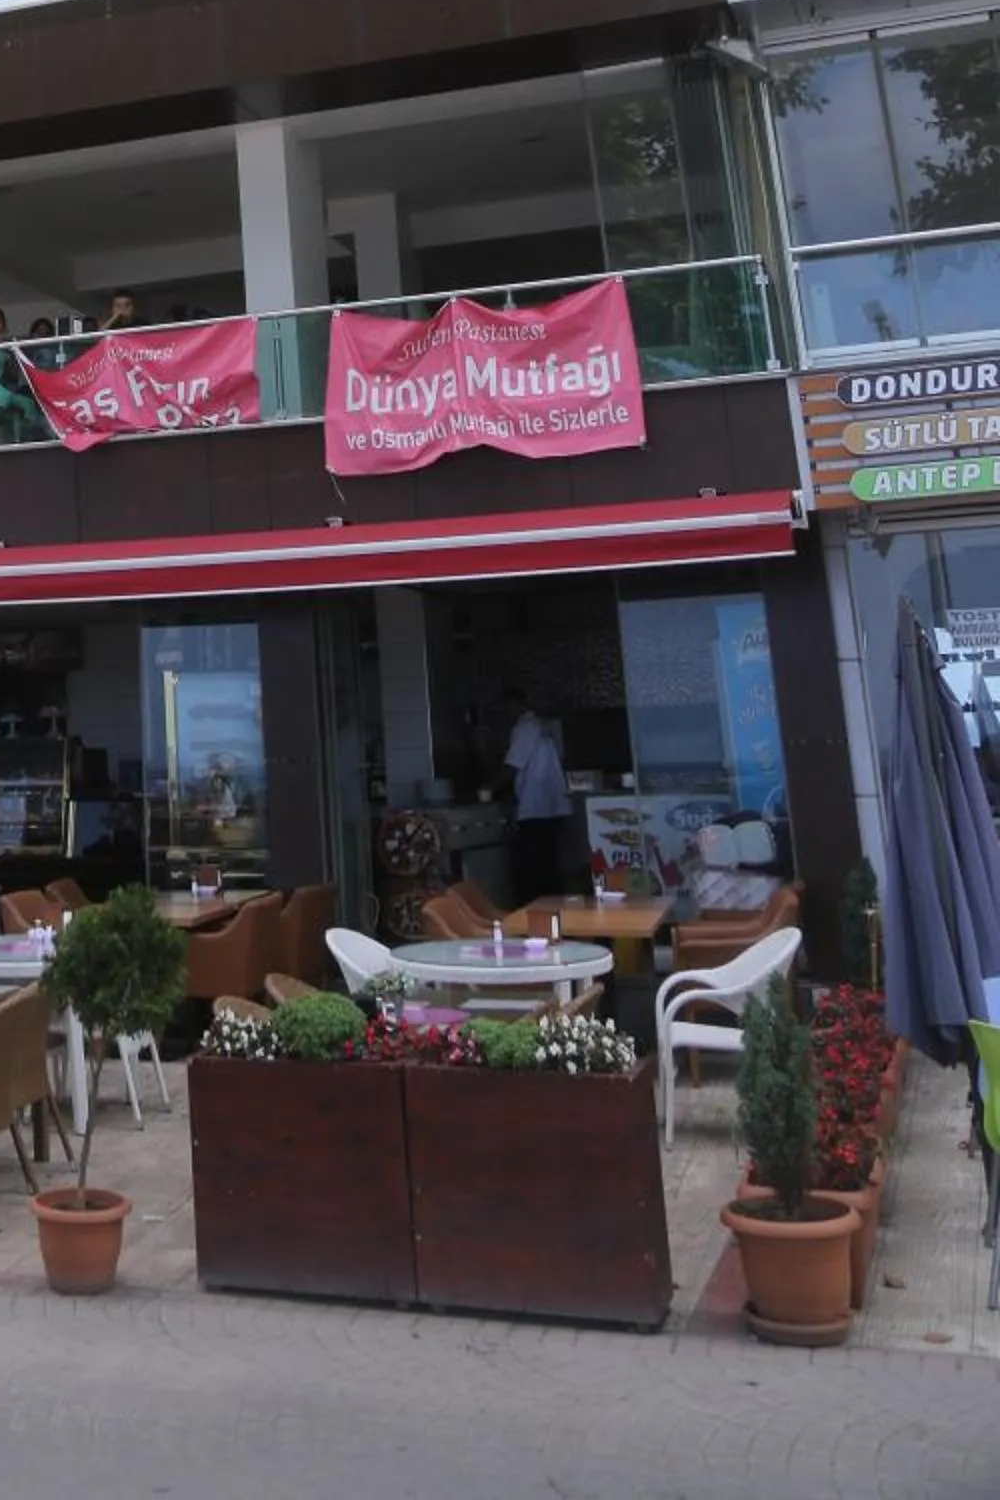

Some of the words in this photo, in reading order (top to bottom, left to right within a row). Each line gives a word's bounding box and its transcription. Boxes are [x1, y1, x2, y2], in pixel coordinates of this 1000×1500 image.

[453, 317, 548, 343] Pastanesi
[345, 367, 457, 417] Dünya
[465, 345, 622, 398] Mutfağı
[851, 363, 1000, 403] DONDUR
[346, 432, 367, 450] ve
[519, 413, 545, 436] ile
[548, 402, 630, 434] Sizlerle
[864, 412, 957, 451] SÜTLÜ
[872, 462, 981, 495] ANTEP
